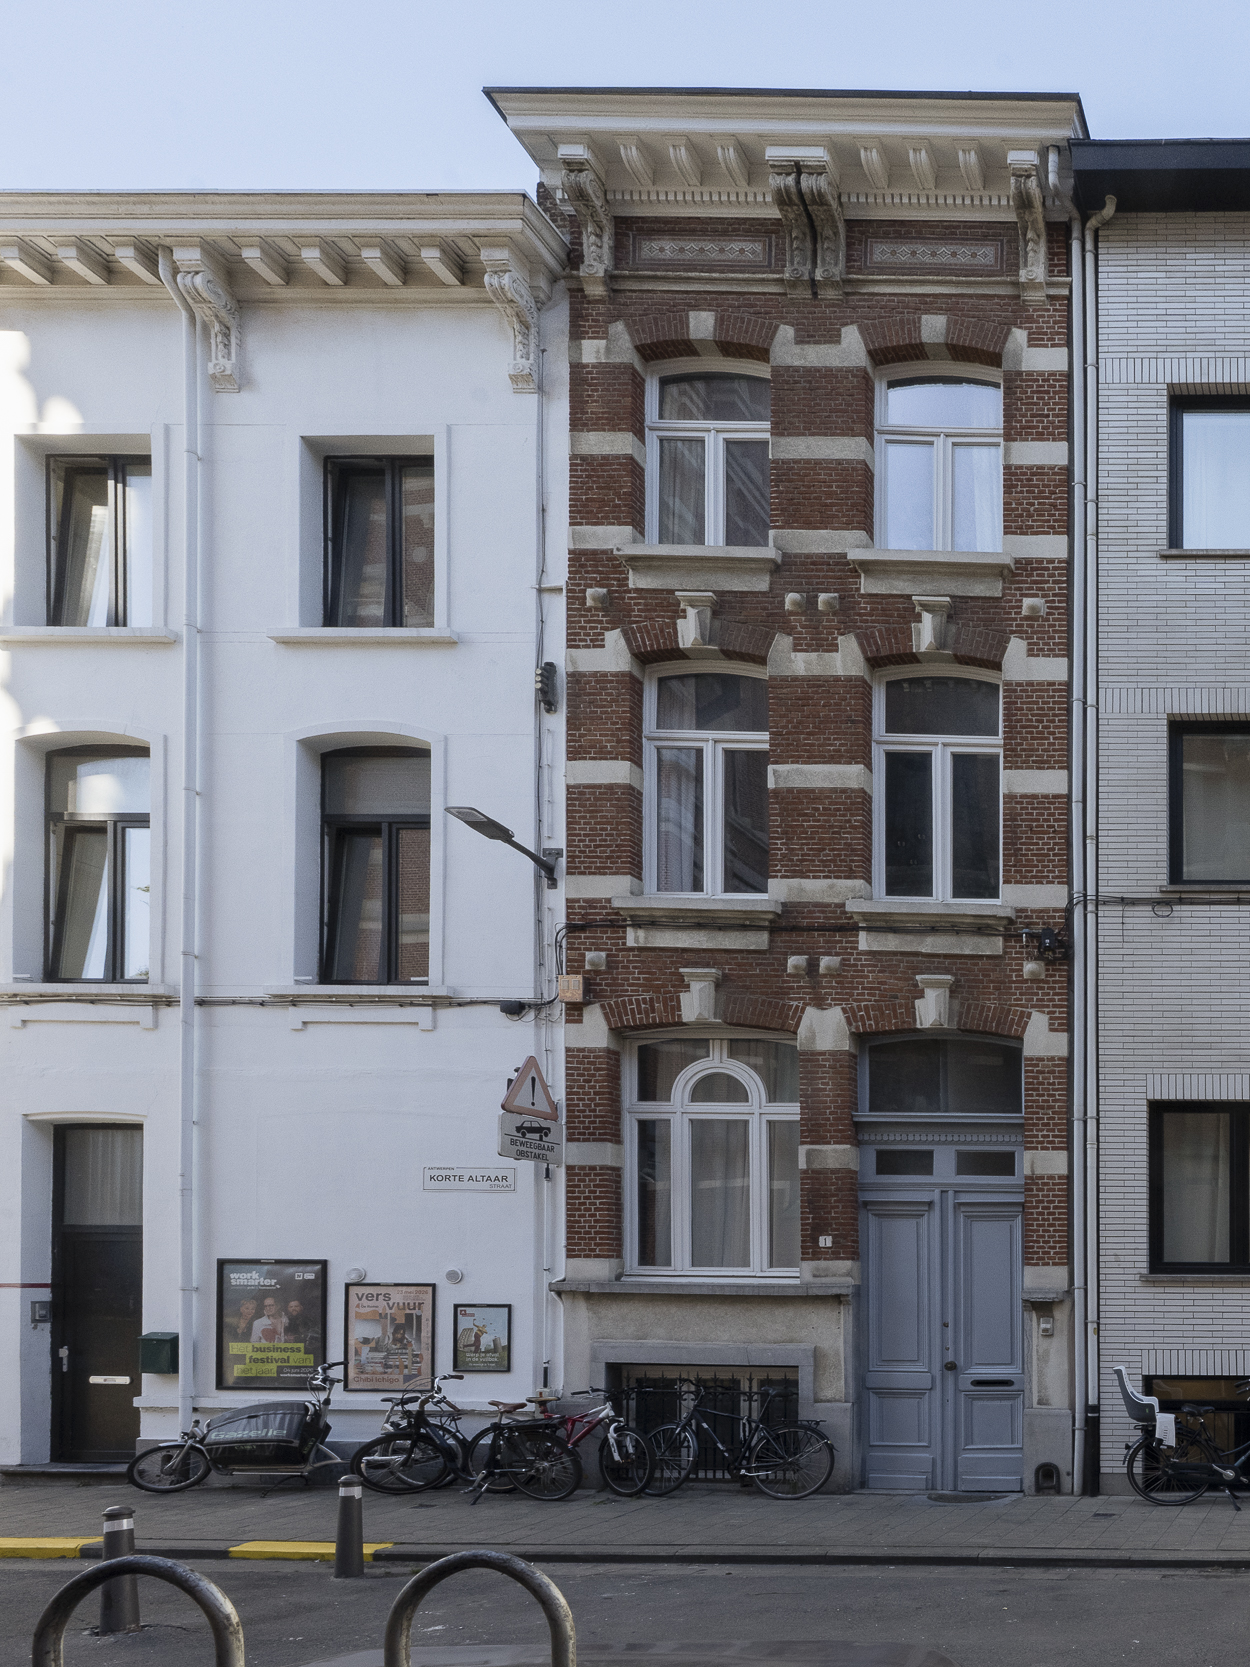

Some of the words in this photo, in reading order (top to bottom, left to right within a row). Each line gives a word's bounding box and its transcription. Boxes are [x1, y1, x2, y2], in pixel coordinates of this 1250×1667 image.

[510, 1138, 555, 1152] BEWEEGBAAR
[516, 1149, 549, 1161] OBSTAKEL
[230, 1271, 260, 1279] work
[230, 1278, 277, 1286] smarter
[355, 1292, 392, 1301] vers
[386, 1302, 424, 1310] vuur
[252, 1345, 302, 1353] business
[248, 1355, 290, 1364] festival
[255, 1367, 275, 1376] jaar.
[375, 1376, 400, 1384] Ichigo
[211, 1429, 287, 1439] Gazelle
